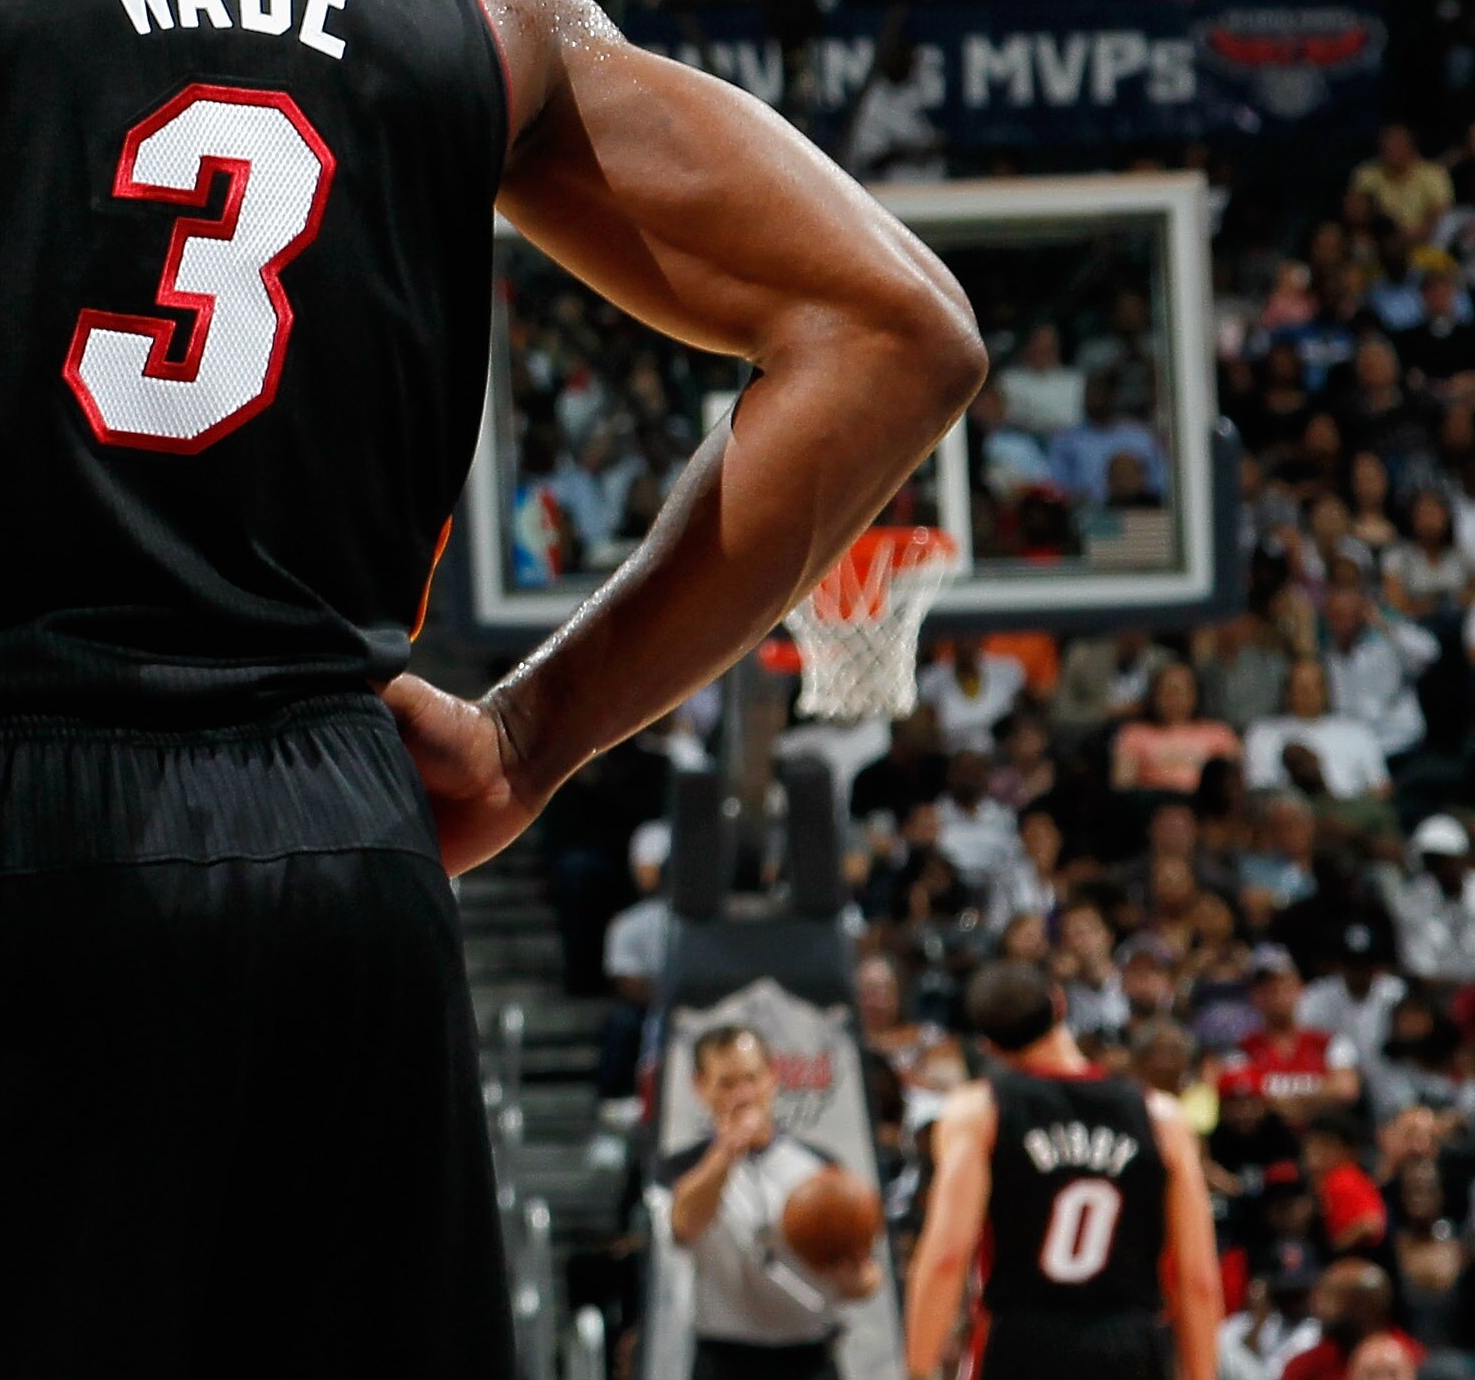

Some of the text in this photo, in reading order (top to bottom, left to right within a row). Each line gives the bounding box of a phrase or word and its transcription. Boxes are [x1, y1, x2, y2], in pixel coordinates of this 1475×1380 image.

[961, 29, 1198, 109] MVPs
[61, 83, 337, 455] 3
[1039, 1177, 1125, 1285] 0
